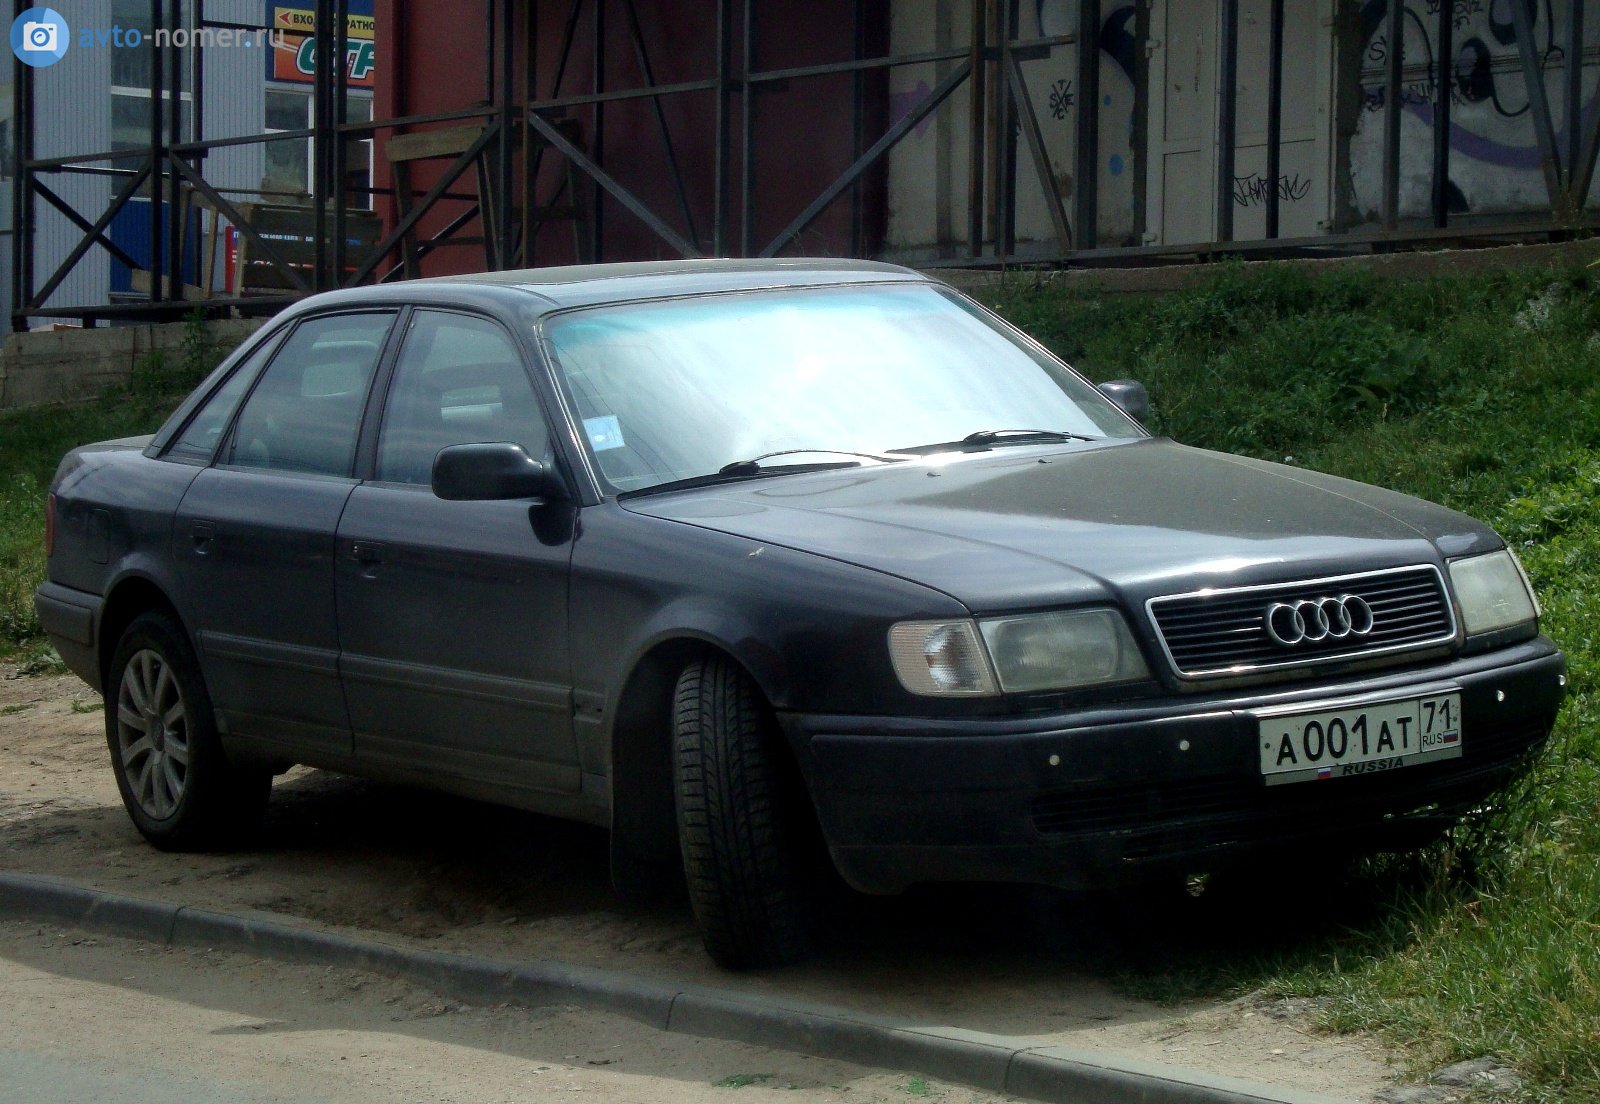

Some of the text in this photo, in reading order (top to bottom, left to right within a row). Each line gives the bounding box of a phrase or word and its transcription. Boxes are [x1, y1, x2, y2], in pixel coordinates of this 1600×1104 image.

[293, 13, 317, 26] ВХО
[1423, 698, 1452, 734] 71
[1422, 732, 1443, 747] RUS
[1342, 757, 1404, 776] RUSSIA
